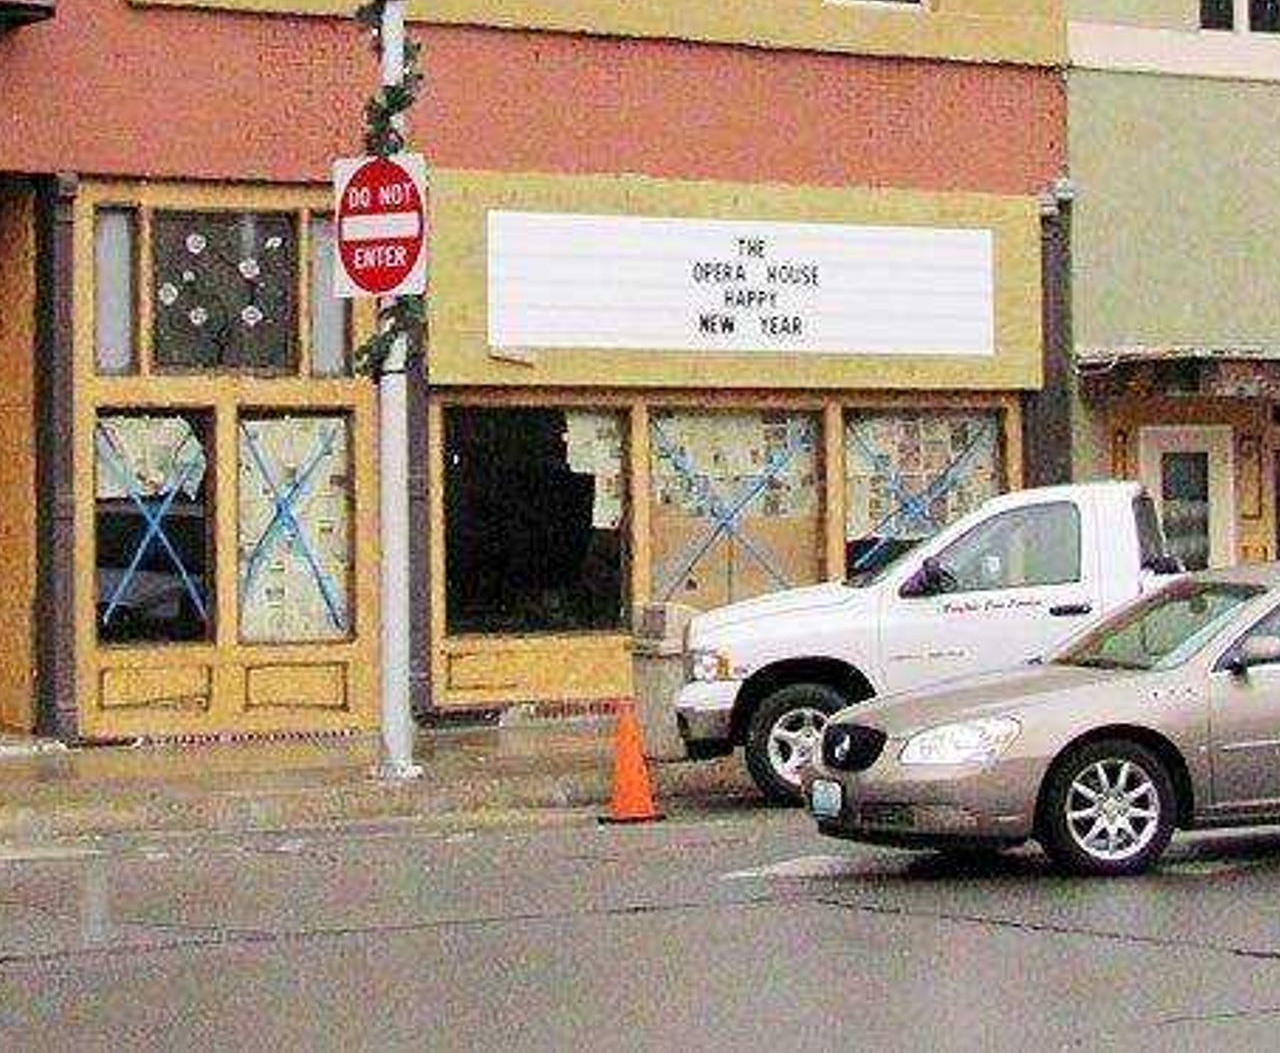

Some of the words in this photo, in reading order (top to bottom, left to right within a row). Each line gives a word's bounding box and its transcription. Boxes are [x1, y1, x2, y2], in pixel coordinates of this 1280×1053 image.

[348, 187, 370, 209] DO
[380, 182, 413, 206] NOT
[354, 246, 406, 268] ENTER
[738, 239, 765, 258] THE
[693, 262, 745, 283] OPERA
[767, 265, 819, 286] HOUSE
[724, 290, 776, 308] HAPPY
[699, 313, 734, 334] NEW
[759, 316, 801, 335] YEAR
